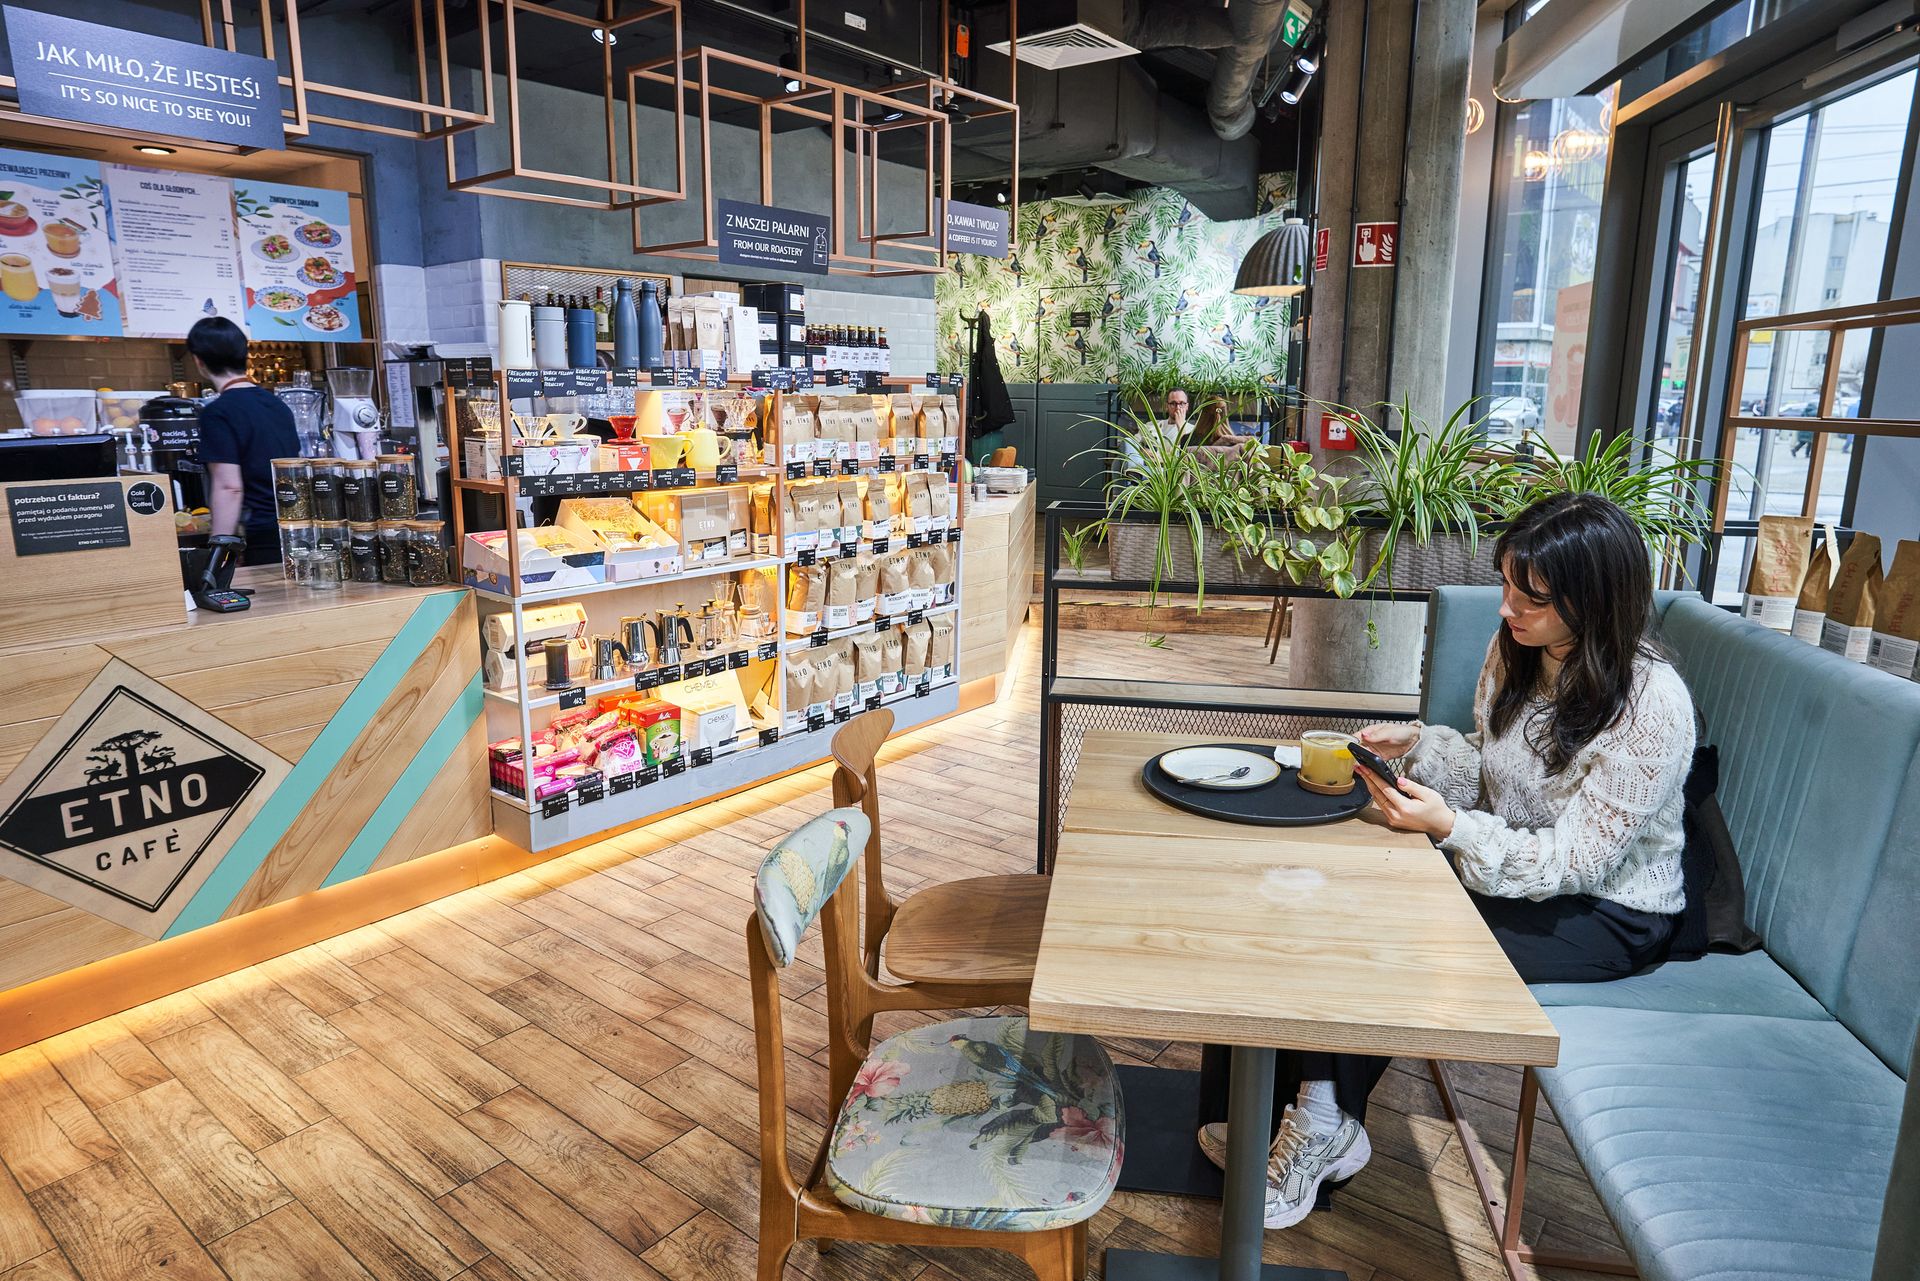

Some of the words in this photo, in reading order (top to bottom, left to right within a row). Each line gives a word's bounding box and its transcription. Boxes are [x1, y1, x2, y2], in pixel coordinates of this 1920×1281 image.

[36, 42, 79, 67] JAK
[86, 51, 150, 82] MIŁO,
[152, 61, 179, 85] ŻE
[185, 70, 261, 99] JESTEŚ!
[61, 84, 92, 102] IT'S
[95, 89, 118, 106] SO
[122, 94, 159, 113] NICE
[161, 100, 183, 117] TO
[187, 105, 214, 122] SEE
[216, 110, 252, 127] YOU!
[726, 214, 733, 227] Z
[735, 215, 770, 232] NASZEJ
[772, 221, 810, 238] PALARNI
[733, 239, 753, 251] FROM
[755, 242, 770, 253] OUR
[771, 244, 803, 257] ROASTERY
[14, 495, 56, 505] potrzebna
[57, 494, 67, 502] Ci
[67, 492, 100, 501] faktura?
[16, 508, 45, 517] pamiętaj
[52, 506, 78, 514] podaniu
[17, 516, 36, 524] przed
[37, 514, 73, 523] wydrukiem
[73, 512, 103, 520] paragonu
[684, 679, 717, 693] CHEMEX
[707, 713, 730, 724] CHEMEX
[60, 773, 208, 839] ETNO
